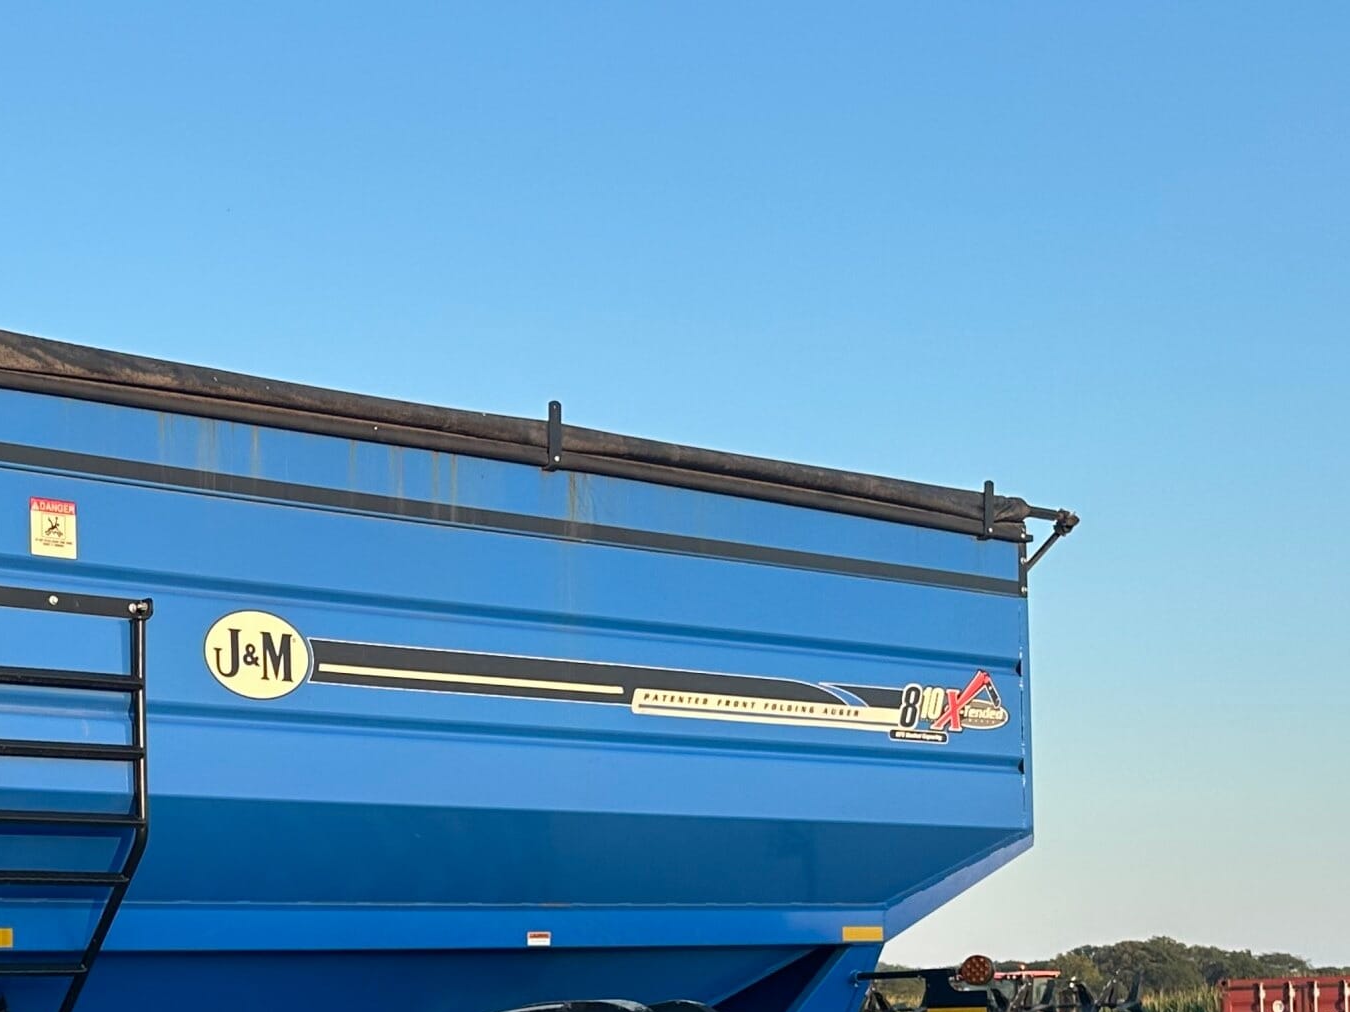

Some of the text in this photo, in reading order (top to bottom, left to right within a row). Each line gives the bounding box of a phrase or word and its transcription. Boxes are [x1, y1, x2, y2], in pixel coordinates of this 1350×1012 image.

[39, 501, 74, 515] DANGER
[213, 628, 294, 683] J&M
[643, 693, 860, 717] PATENTED FRONT FOLDING AUGER
[900, 686, 944, 728] 810
